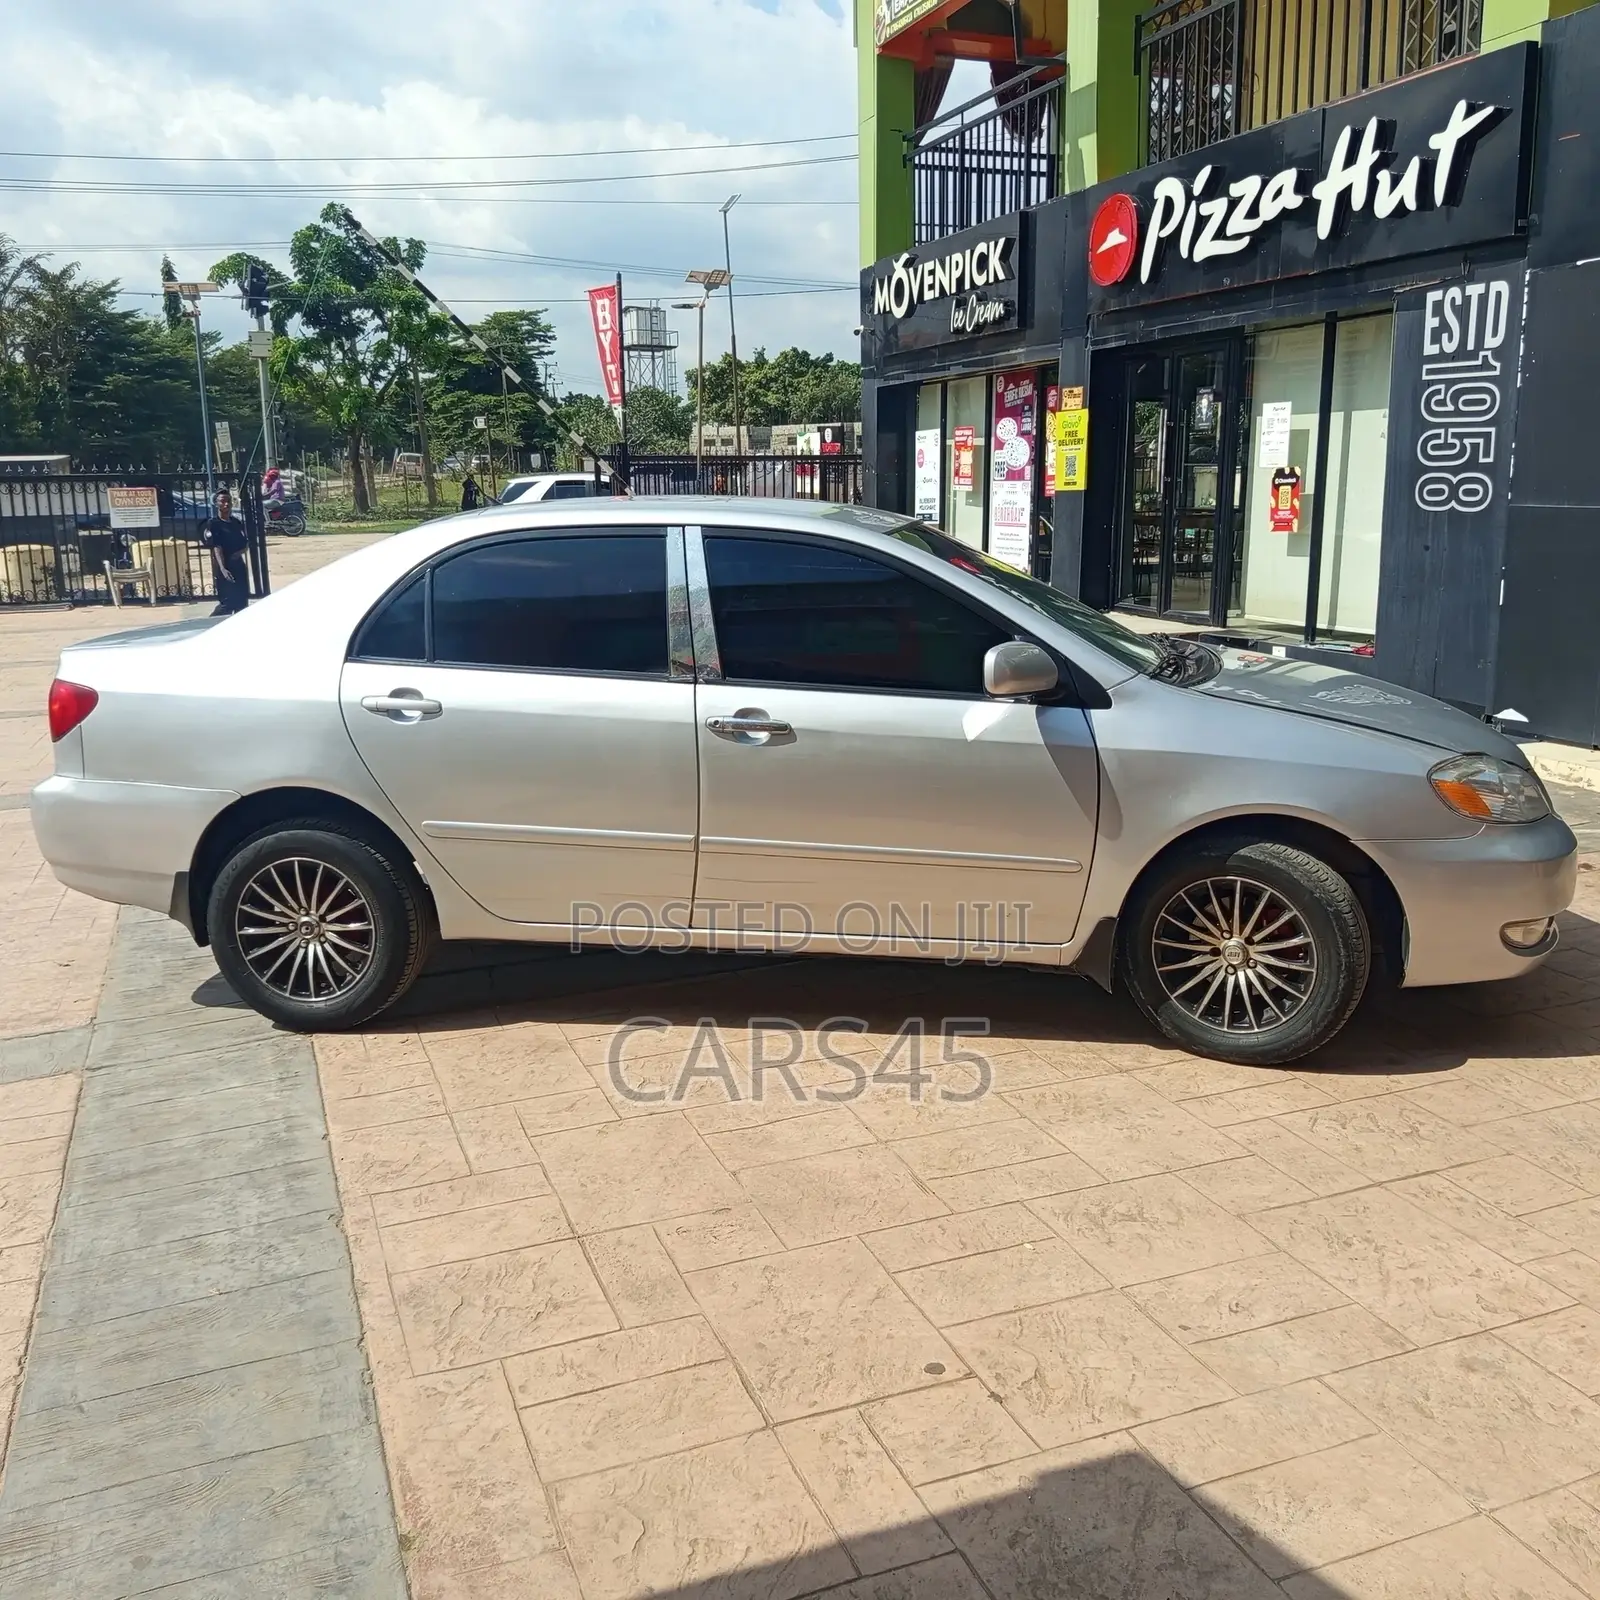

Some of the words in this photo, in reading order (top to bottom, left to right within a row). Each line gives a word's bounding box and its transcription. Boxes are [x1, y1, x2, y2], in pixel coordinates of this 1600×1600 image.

[1140, 164, 1303, 284] Pizza
[1312, 99, 1495, 240] Hut
[950, 299, 966, 333] Ice
[966, 294, 1005, 332] Cream
[1423, 280, 1509, 356] ESTD
[1058, 438, 1084, 447] DELIVERY
[1064, 430, 1078, 438] FREE
[1415, 350, 1501, 512] 1958
[111, 490, 128, 498] PARK
[115, 498, 134, 506] OWN
[136, 497, 153, 506] RISK
